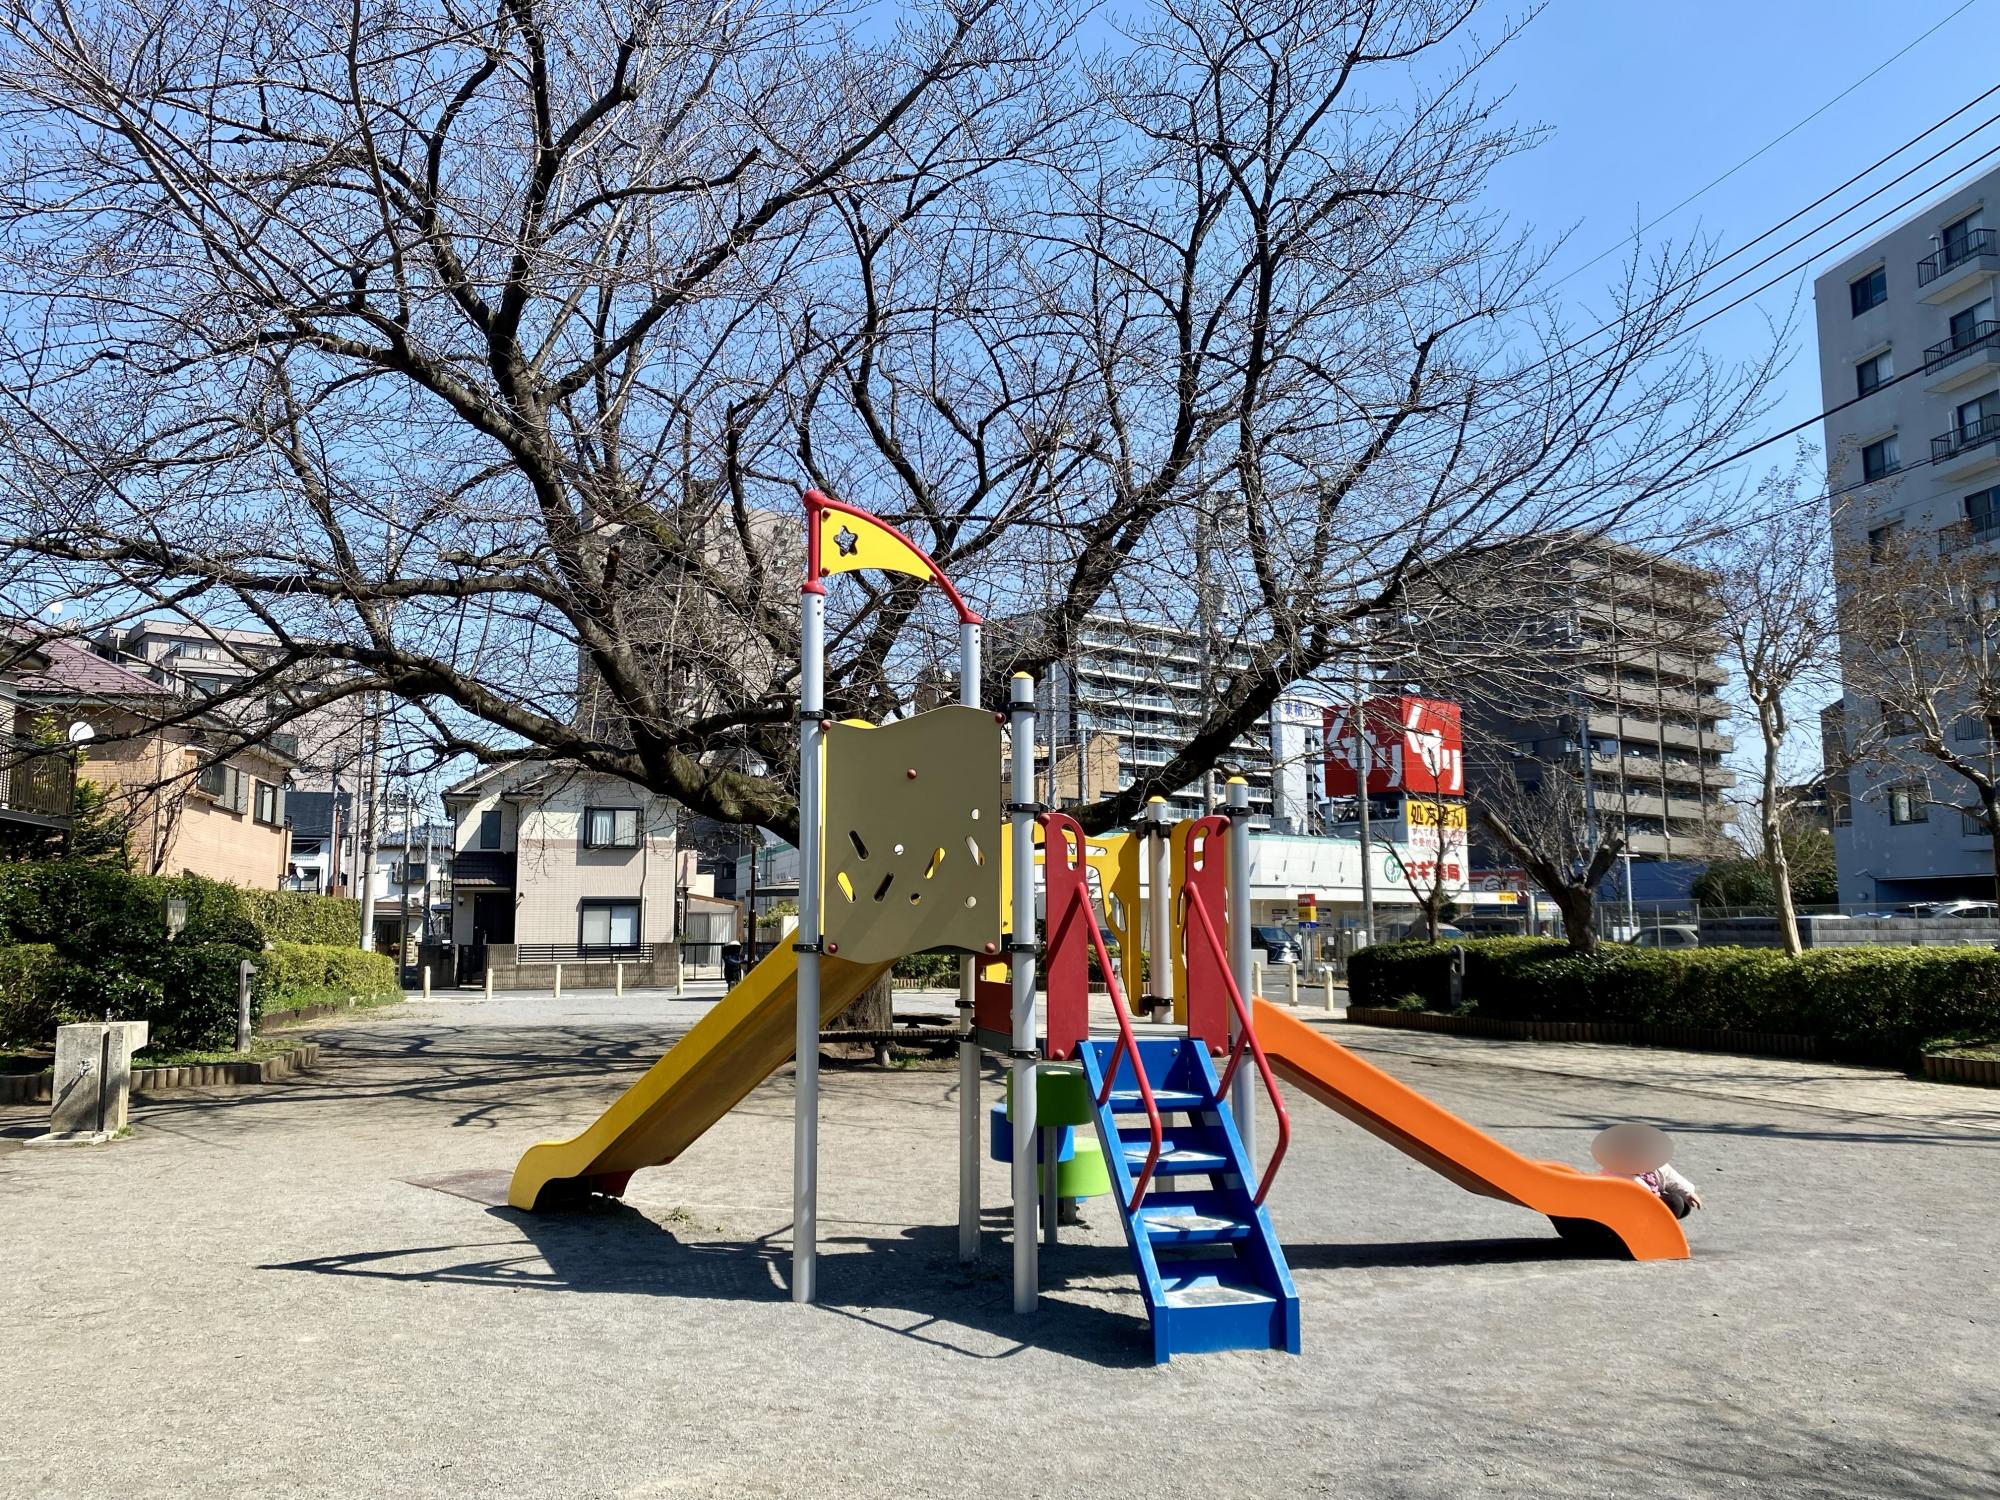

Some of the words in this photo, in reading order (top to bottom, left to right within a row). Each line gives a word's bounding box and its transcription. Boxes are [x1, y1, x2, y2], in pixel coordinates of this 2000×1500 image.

[1327, 709, 1403, 787] くすり
[1406, 703, 1462, 790] くすり
[1403, 860, 1460, 881] スギ薬局
